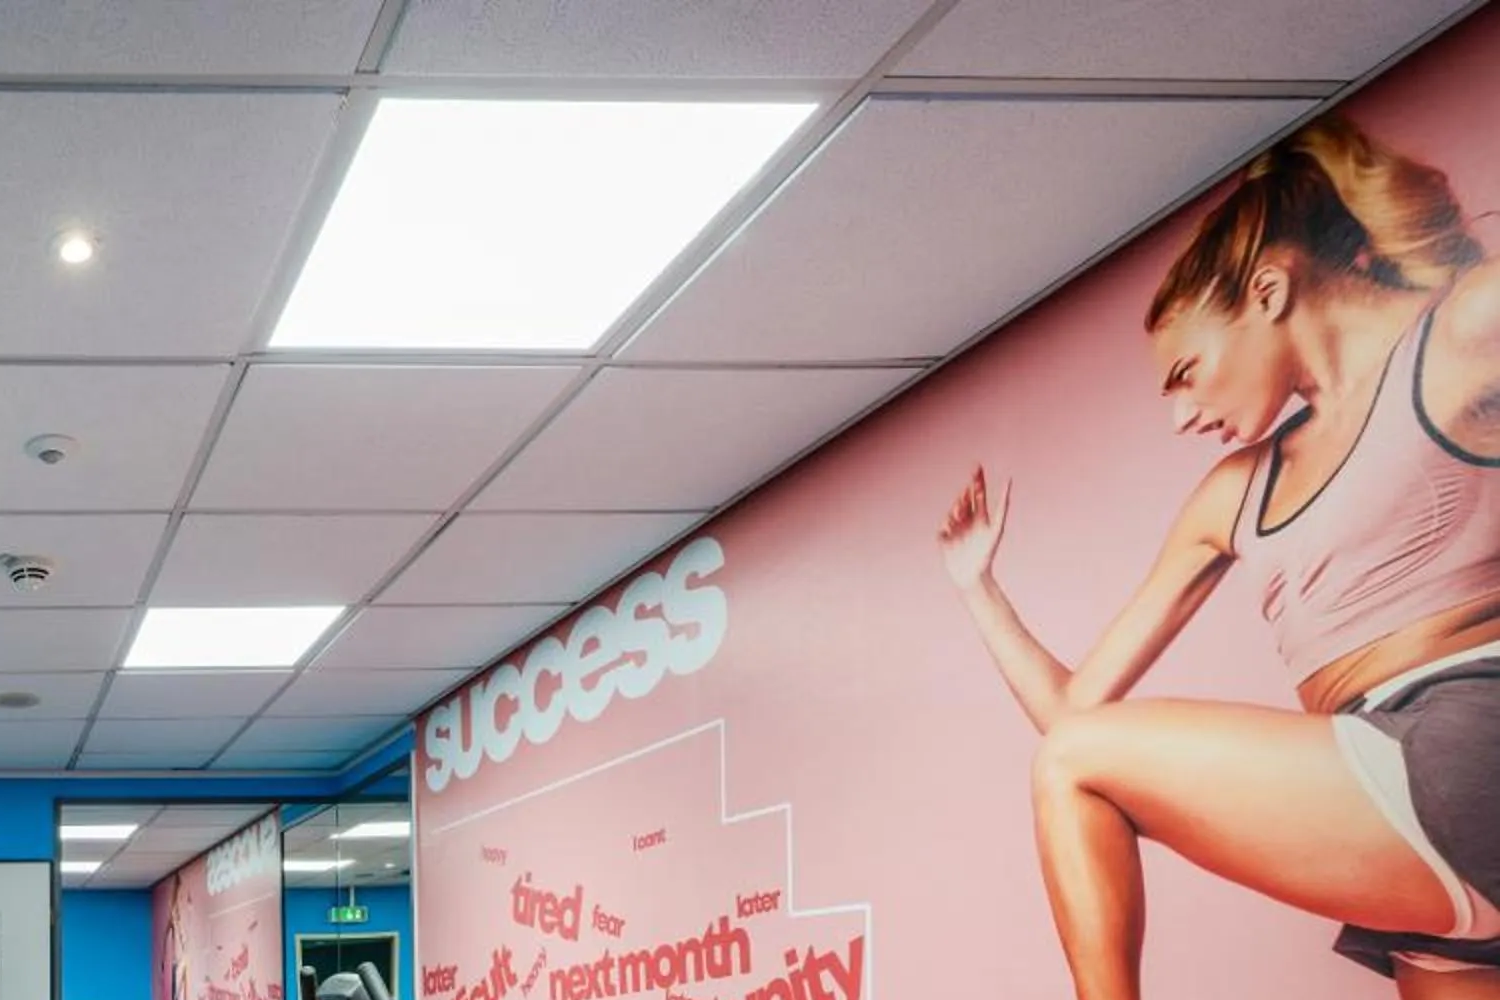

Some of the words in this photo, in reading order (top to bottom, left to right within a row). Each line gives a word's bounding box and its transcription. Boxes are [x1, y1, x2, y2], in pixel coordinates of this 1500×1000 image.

[426, 537, 728, 792] success
[511, 871, 584, 942] tired
[592, 903, 626, 938] fear
[736, 890, 781, 919] later
[422, 964, 459, 996] later
[618, 915, 752, 995] month
